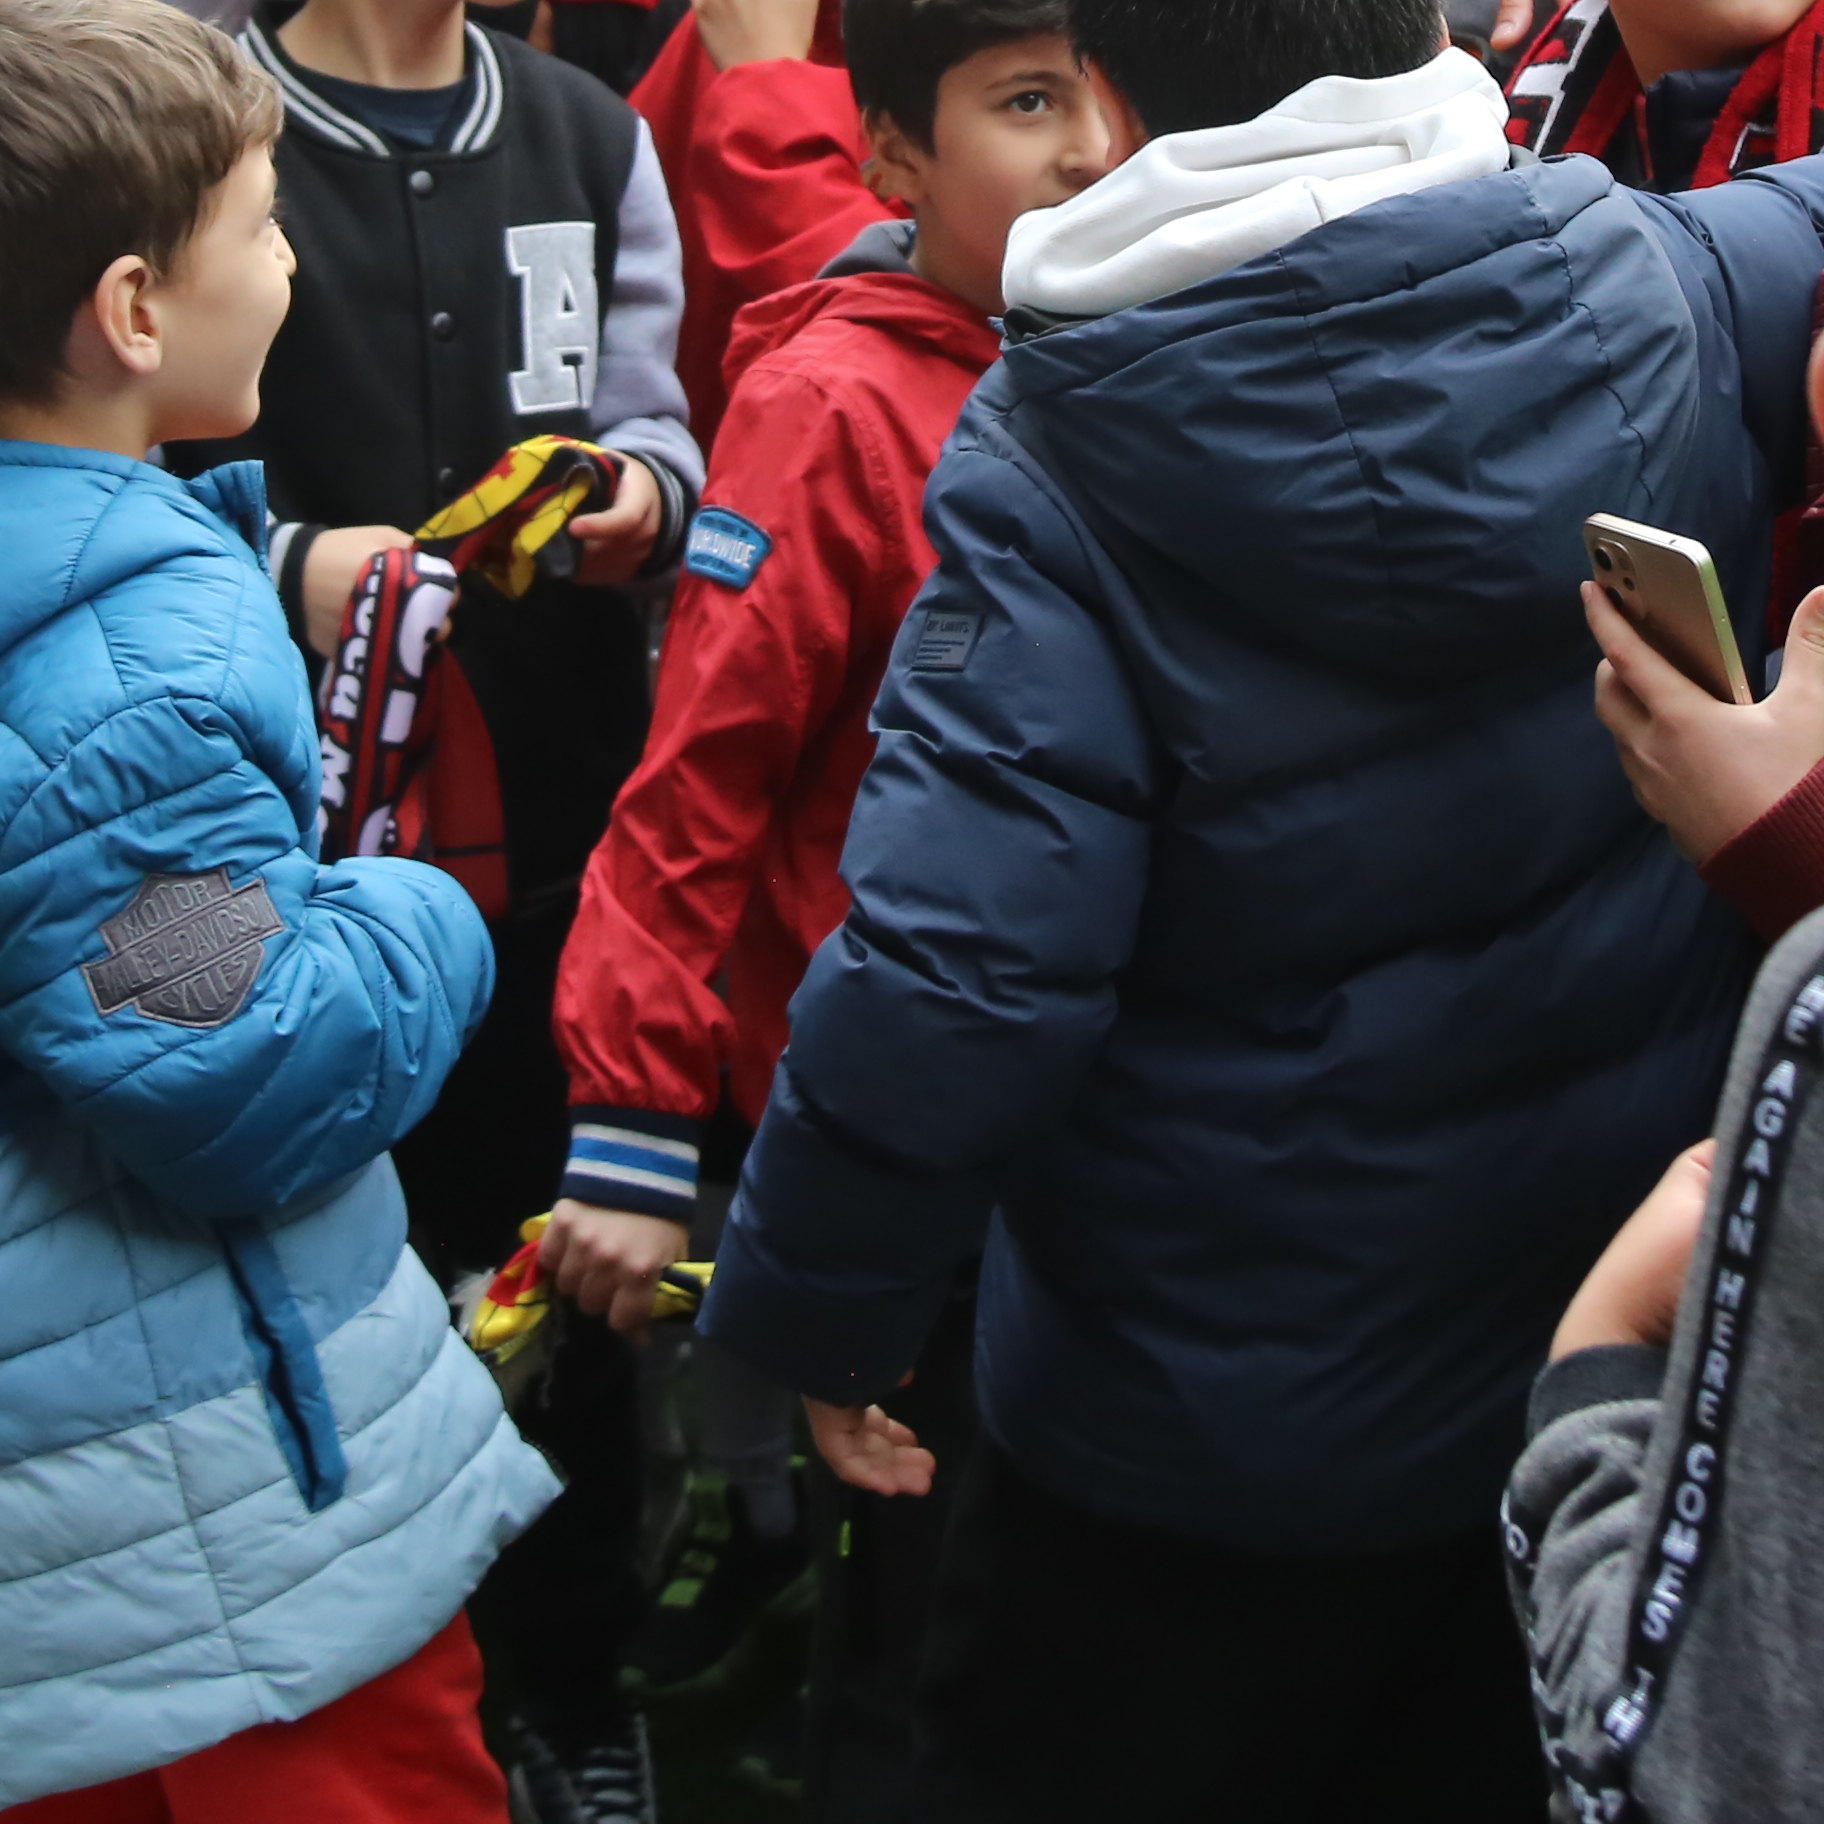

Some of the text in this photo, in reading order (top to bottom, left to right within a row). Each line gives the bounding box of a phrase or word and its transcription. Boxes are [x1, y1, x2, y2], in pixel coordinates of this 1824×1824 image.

[507, 221, 598, 416] A
[1726, 1058, 1797, 1257] AGAIN
[1695, 1266, 1745, 1429] HERE
[1641, 1442, 1717, 1643] COMES
